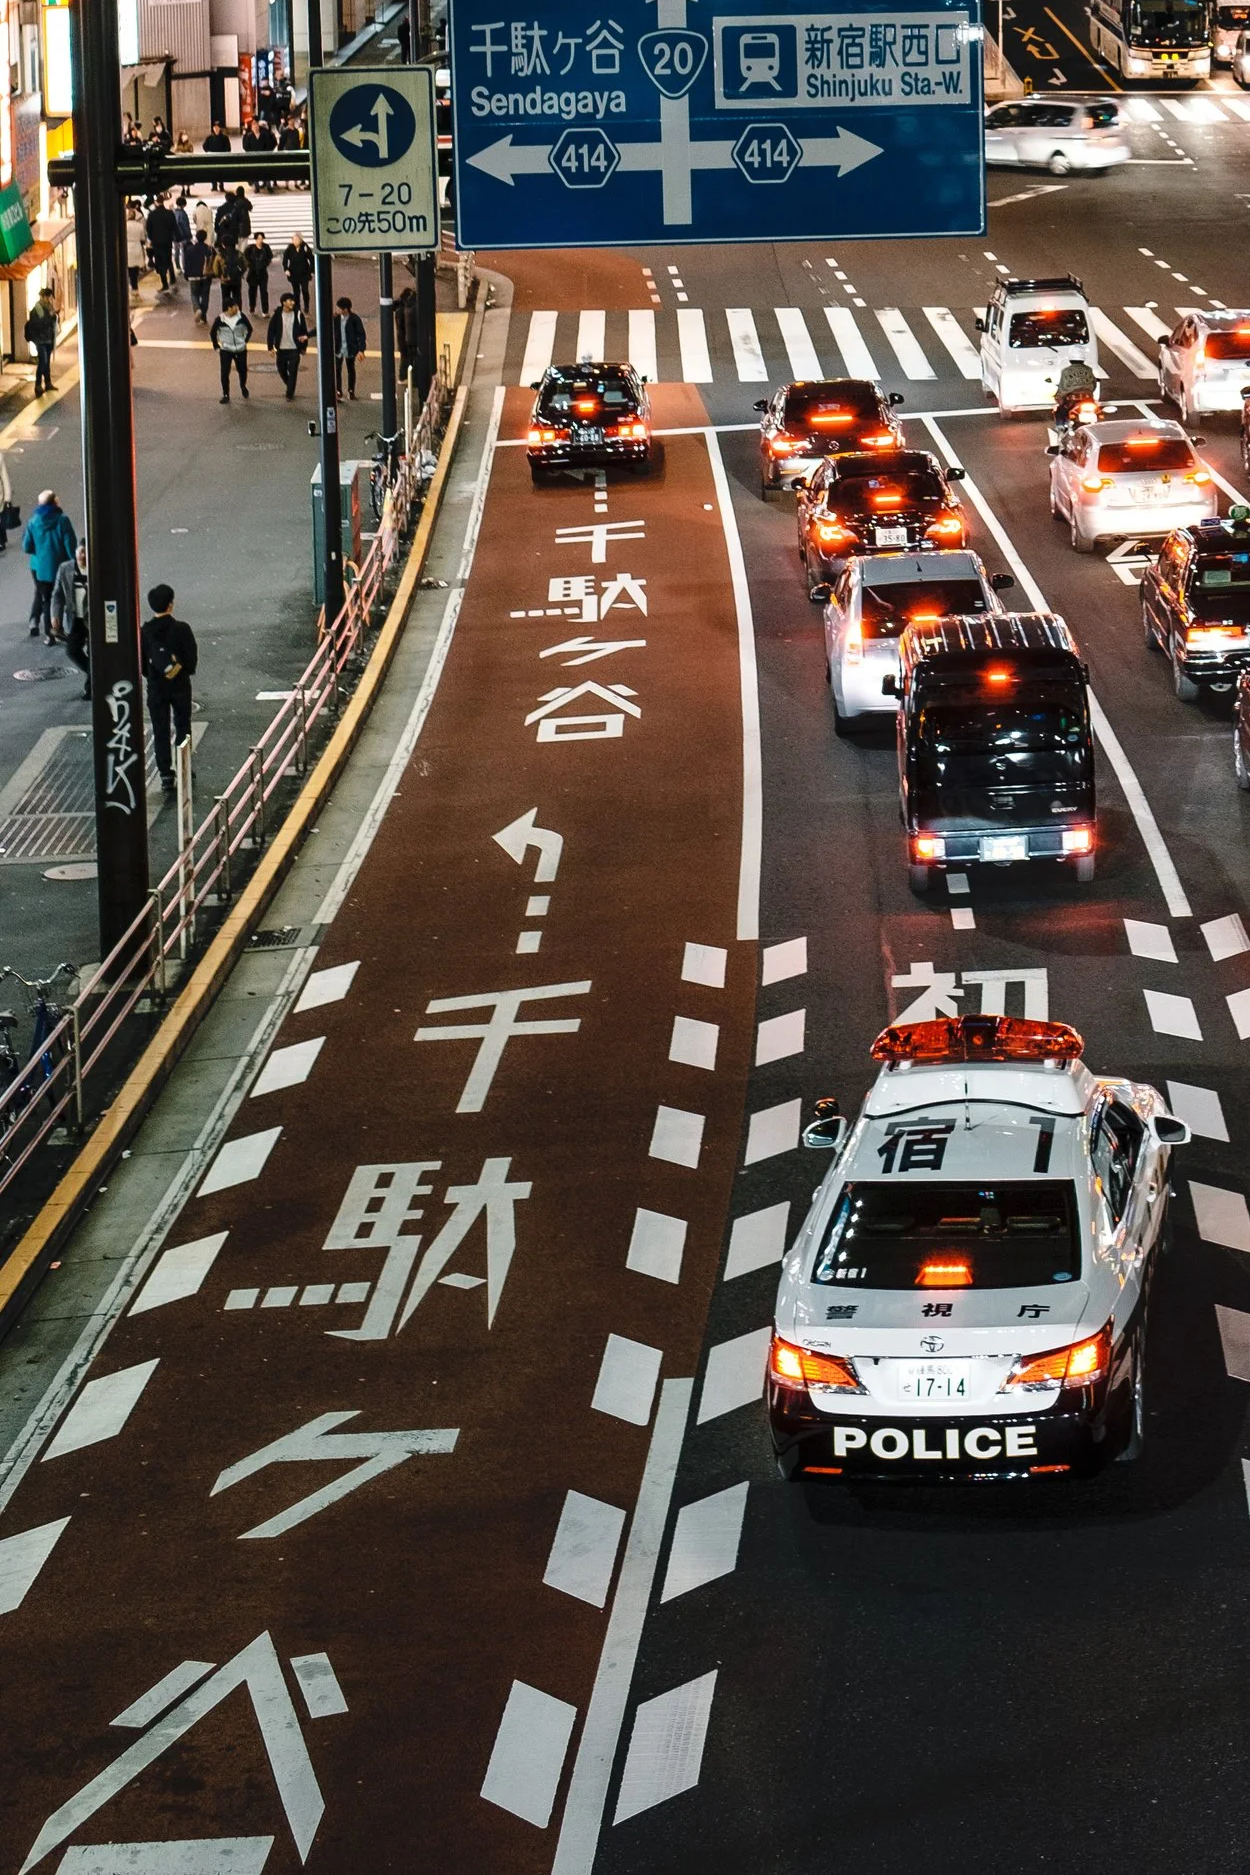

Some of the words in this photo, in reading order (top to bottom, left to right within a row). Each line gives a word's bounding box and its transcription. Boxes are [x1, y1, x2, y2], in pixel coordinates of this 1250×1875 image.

[653, 41, 693, 75] 20
[804, 23, 963, 71] 新宿駅西口
[806, 74, 893, 100] Shinjuku
[471, 86, 627, 120] Sendagaya
[561, 145, 608, 173] 414
[744, 140, 791, 168] 414
[326, 211, 428, 235] この先50m
[877, 1117, 958, 1174] 宿
[1032, 1115, 1056, 1173] 1
[826, 1302, 1052, 1321] 警視庁
[917, 1378, 966, 1397] 17-14
[832, 1424, 1039, 1461] POLICE
